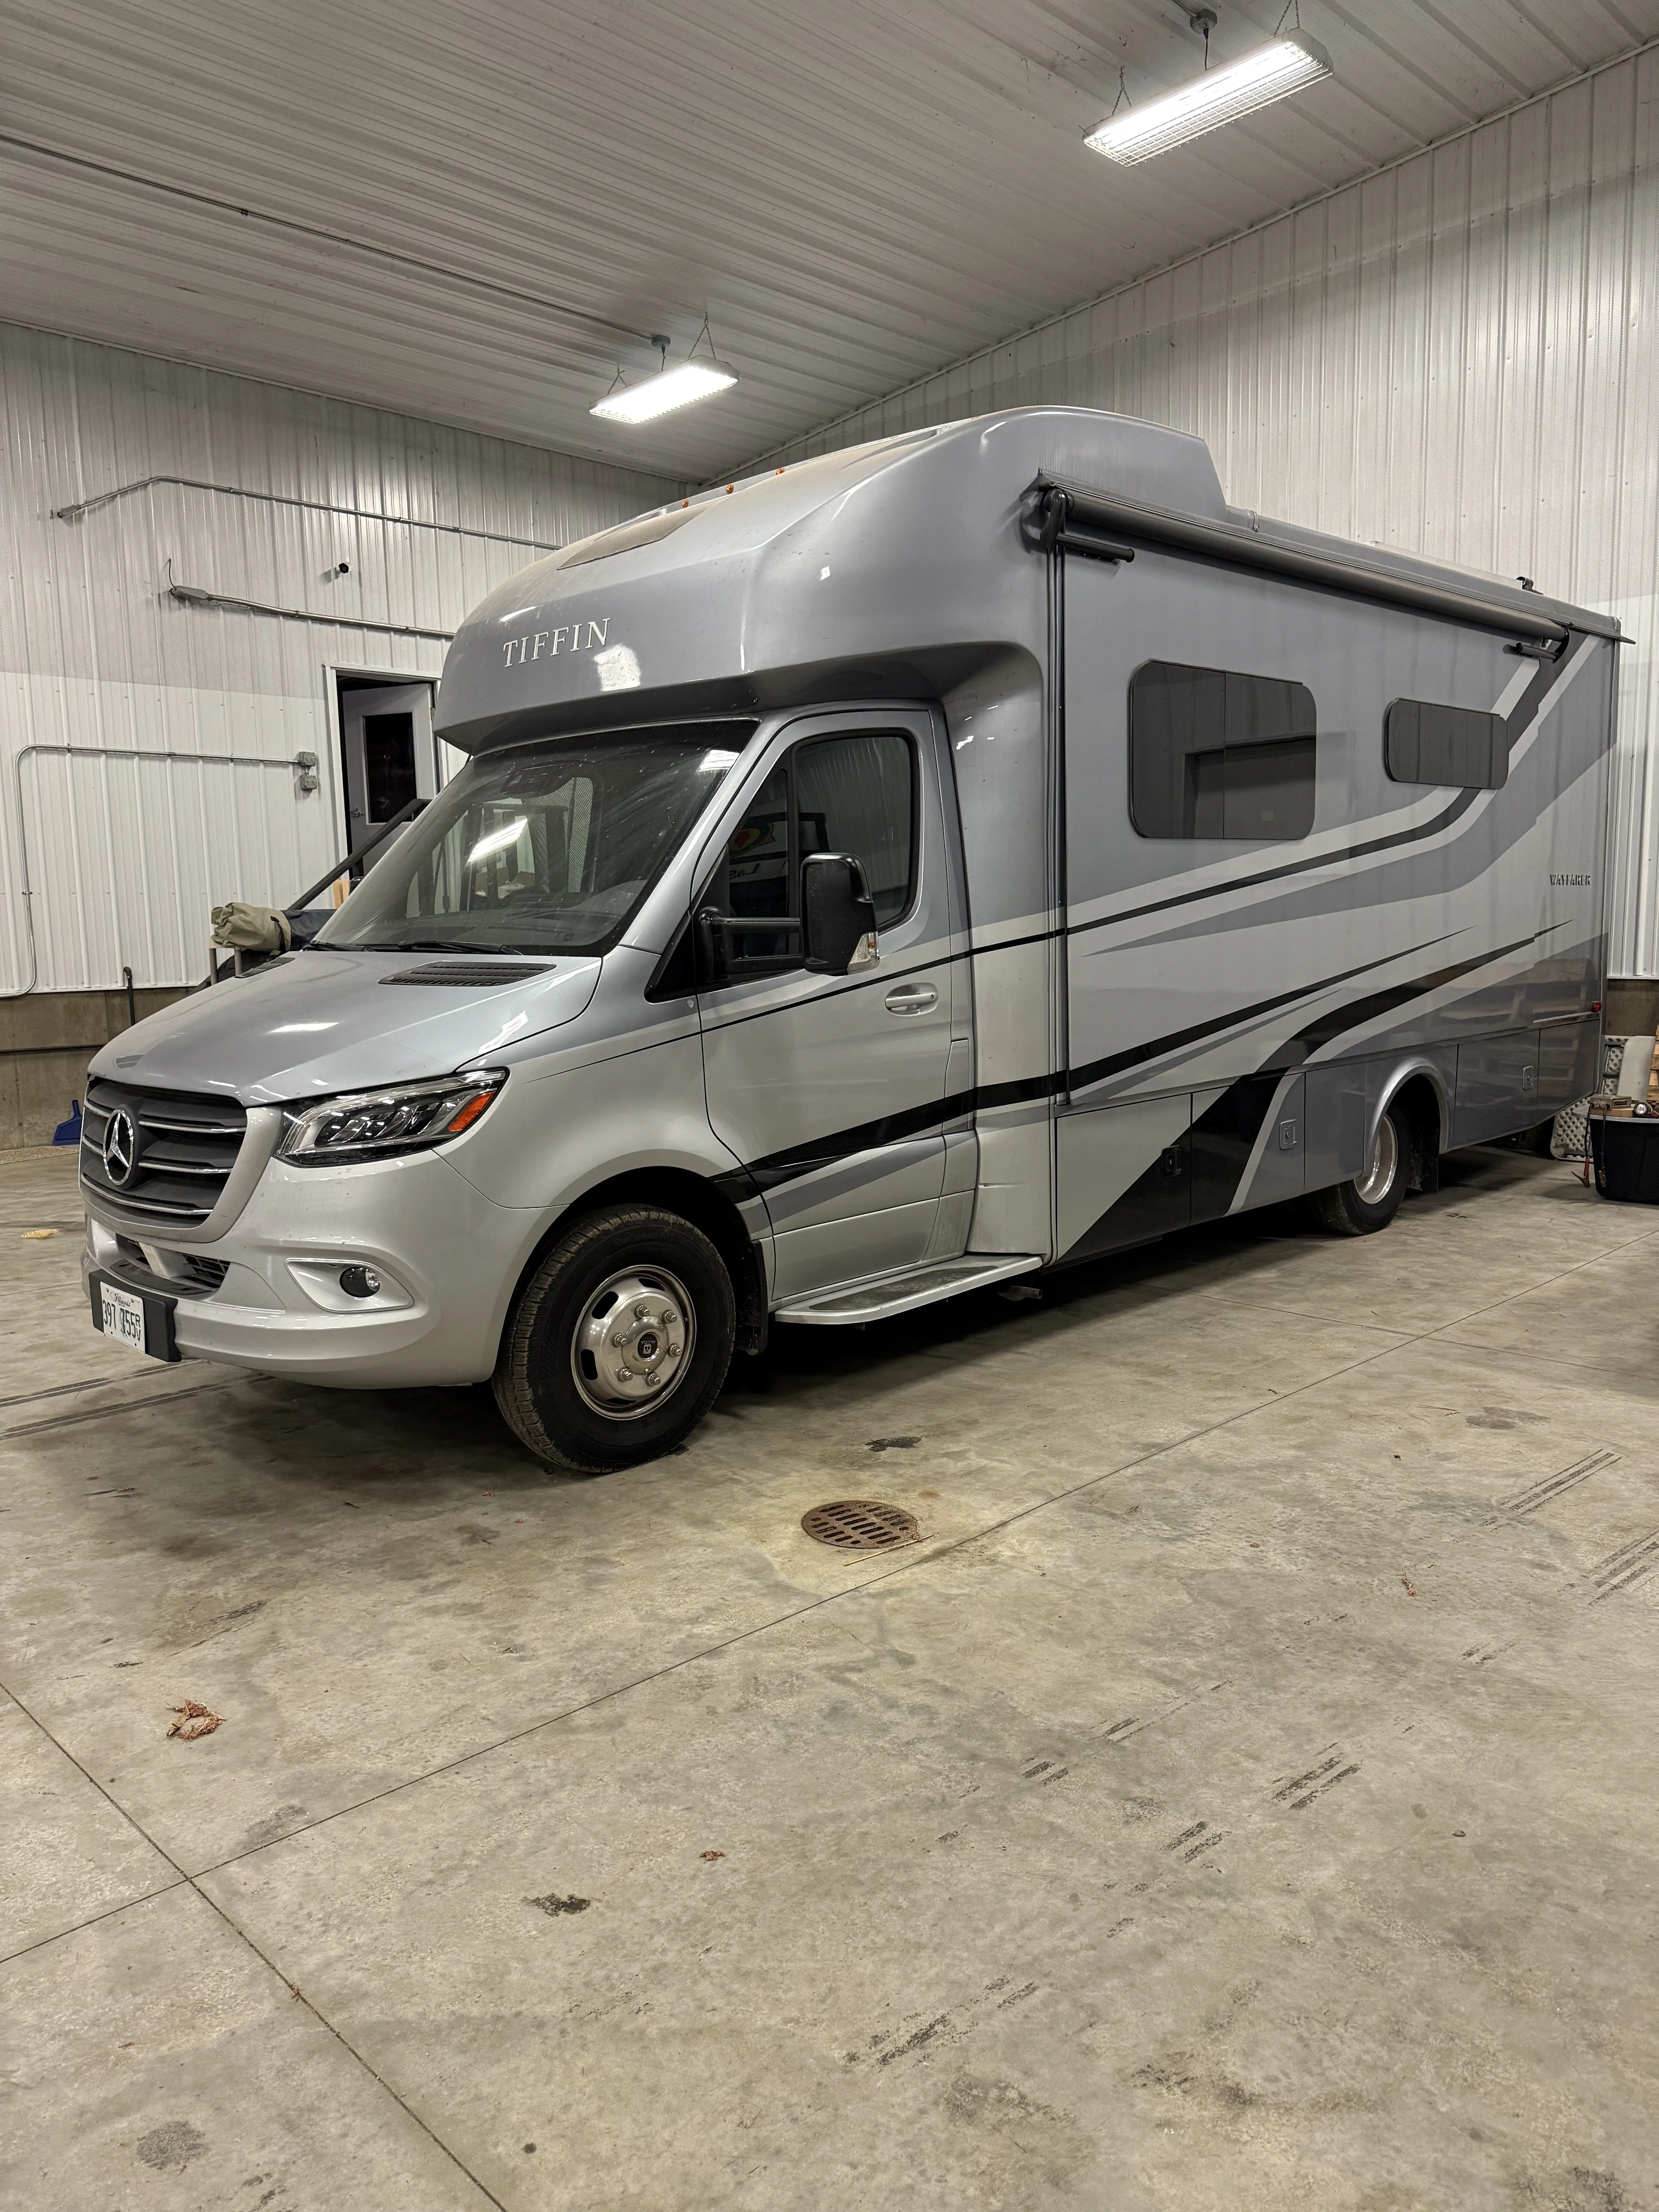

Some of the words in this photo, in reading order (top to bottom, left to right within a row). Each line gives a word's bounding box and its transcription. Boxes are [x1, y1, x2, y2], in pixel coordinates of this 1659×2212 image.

[503, 618, 611, 668] TIFFIN
[110, 1291, 131, 1307] Illinois
[103, 1300, 116, 1329] 397
